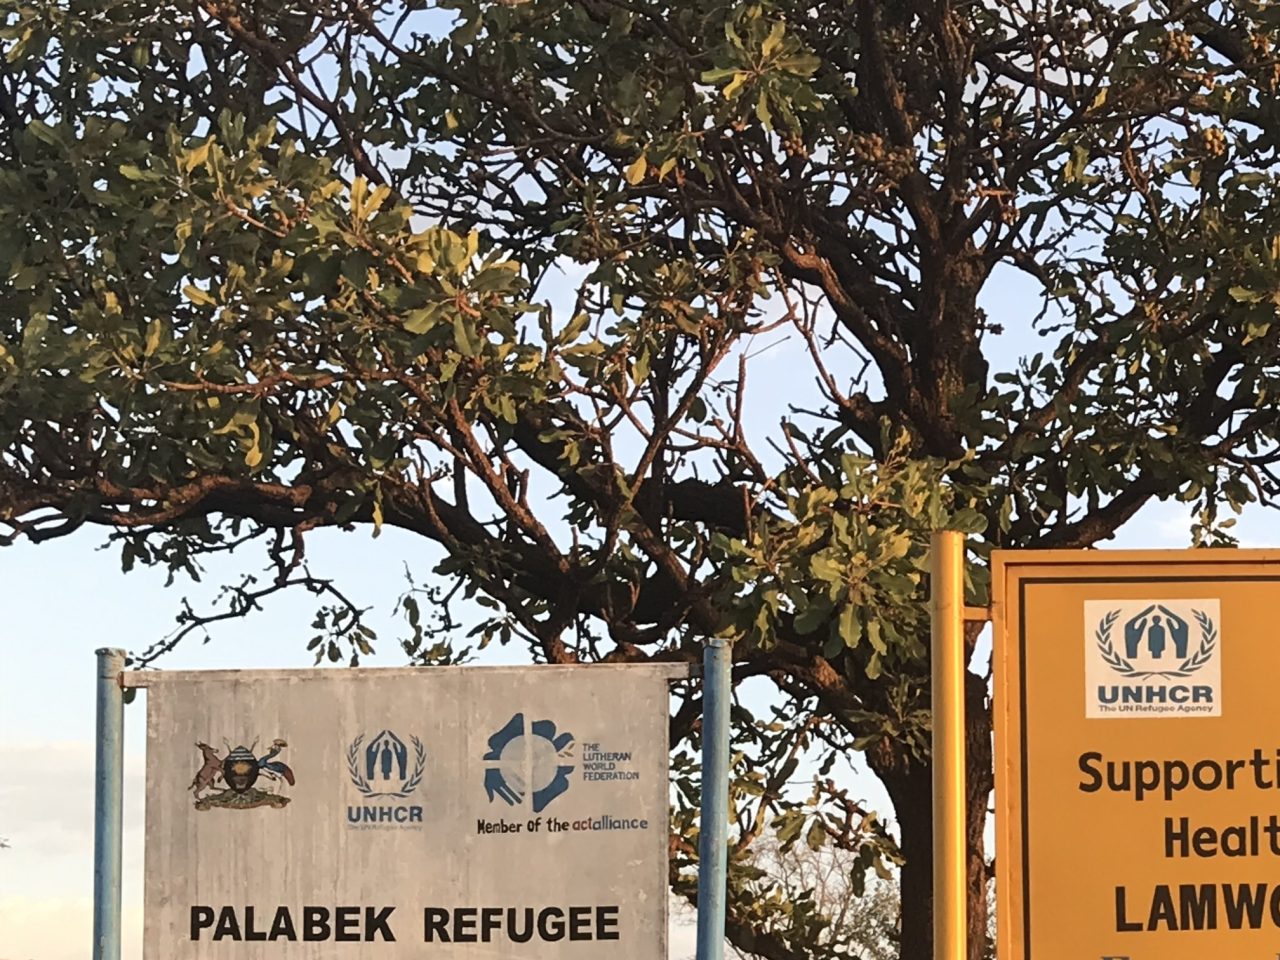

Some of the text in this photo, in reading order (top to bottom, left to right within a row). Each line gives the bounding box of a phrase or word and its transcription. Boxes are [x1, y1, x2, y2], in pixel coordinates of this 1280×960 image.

[1097, 685, 1214, 704] UNHCR
[1098, 704, 1214, 713] The UN Refugee Agency
[582, 742, 601, 751] THE
[582, 752, 633, 761] LUTHERAN
[582, 762, 617, 770] WORLD
[582, 771, 641, 781] FEDERATION
[347, 805, 423, 824] UNHCR
[477, 818, 523, 835] Member
[546, 817, 570, 833] the
[190, 905, 620, 944] PALABEK REFUGEE
